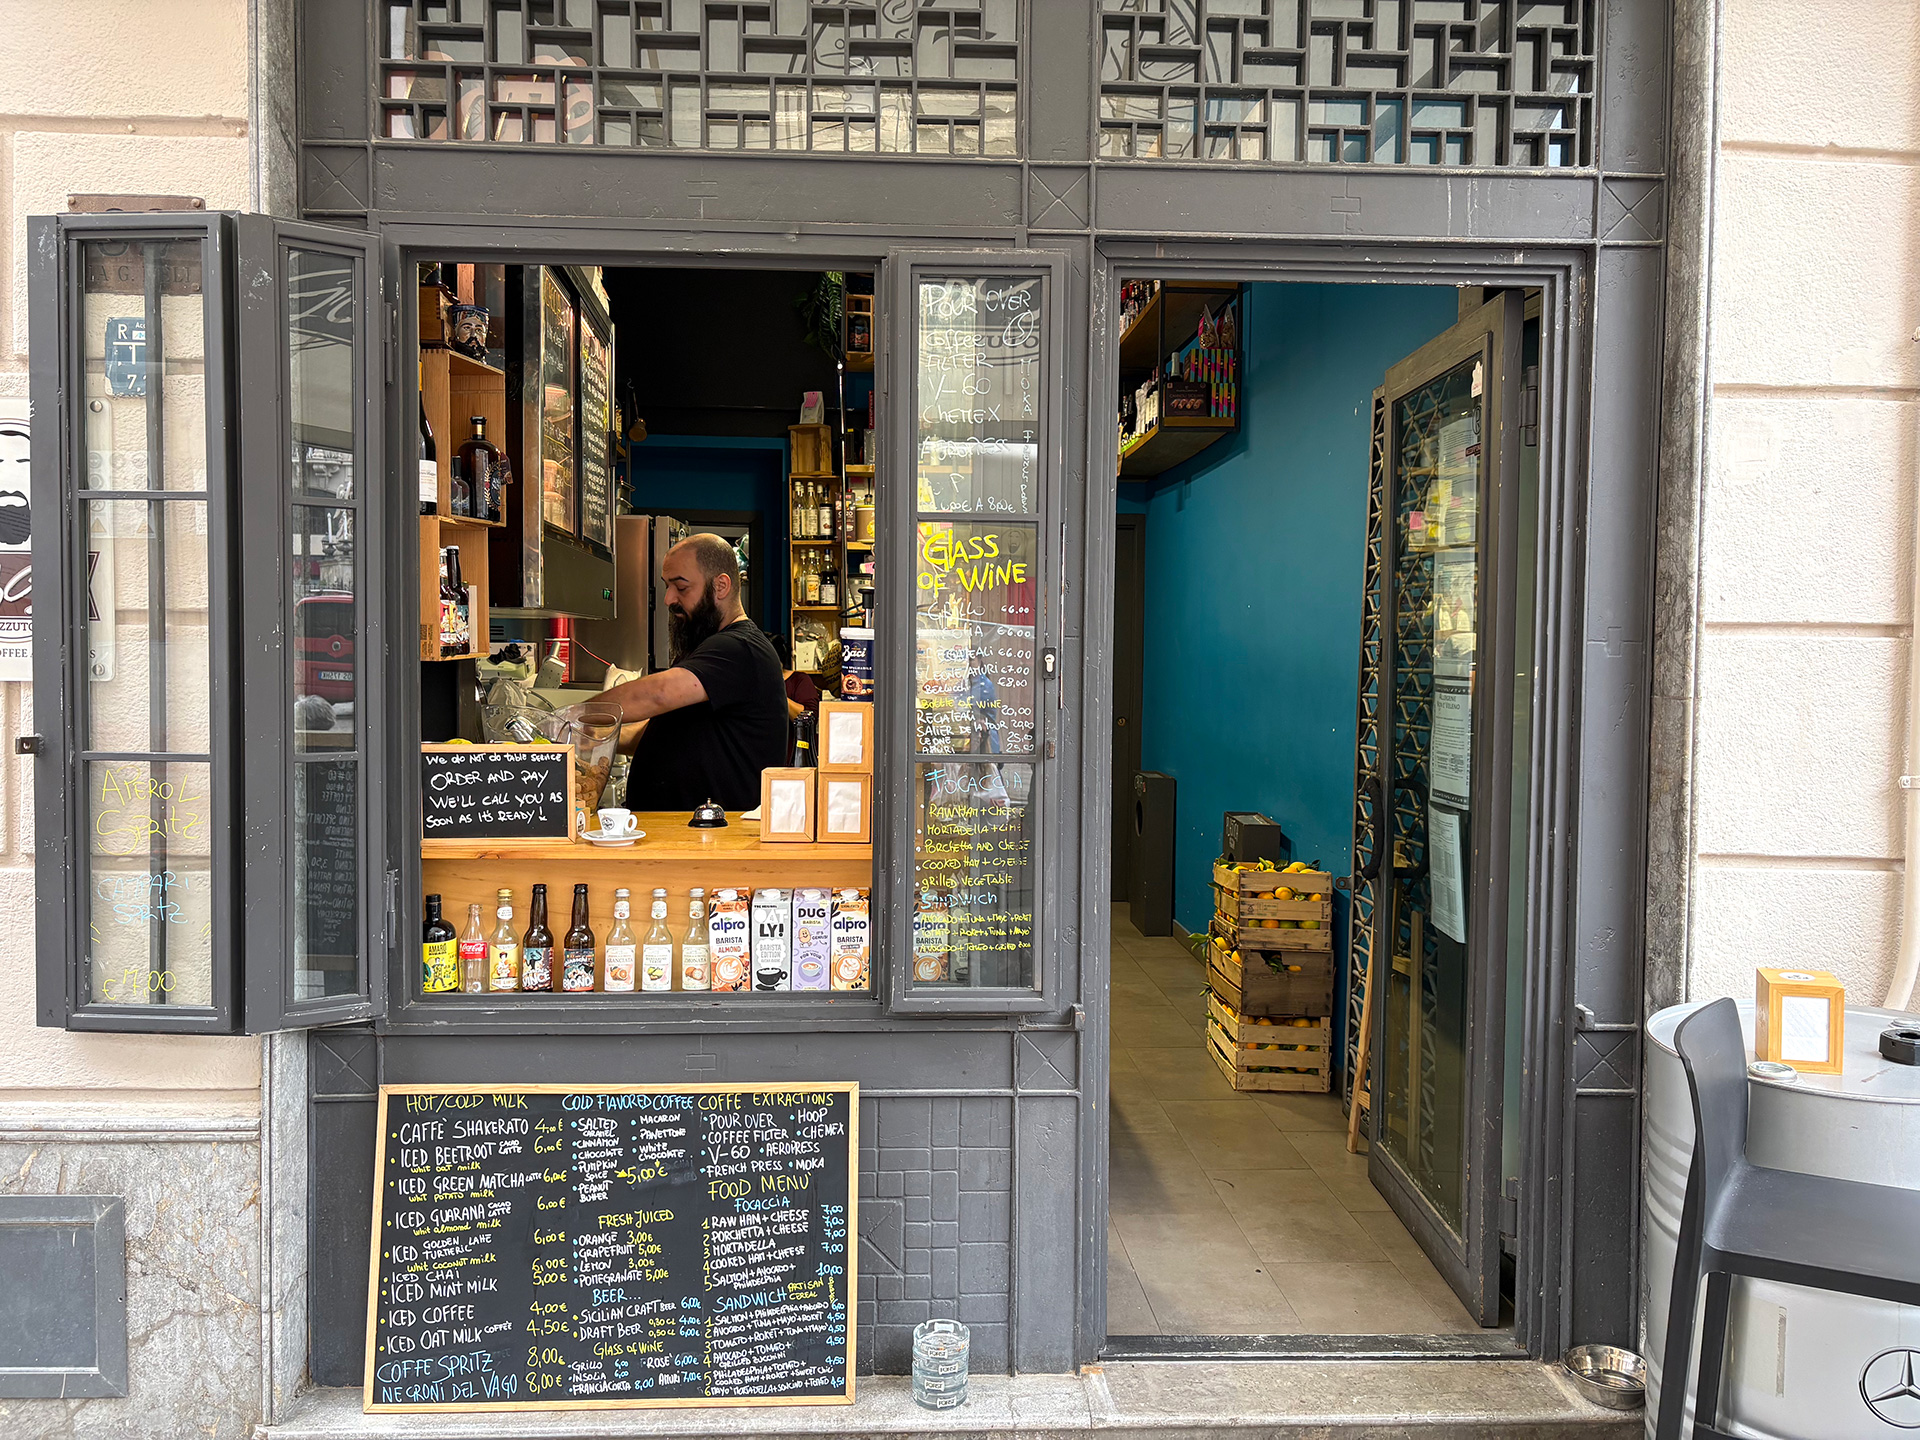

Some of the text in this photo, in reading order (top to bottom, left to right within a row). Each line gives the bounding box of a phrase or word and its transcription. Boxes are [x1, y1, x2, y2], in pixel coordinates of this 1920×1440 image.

[985, 285, 1031, 312] OVER
[117, 323, 128, 340] R
[956, 559, 1028, 593] WINE
[841, 644, 867, 662] Baci
[451, 755, 466, 765] do
[488, 752, 502, 762] do
[430, 769, 549, 791] ORDER AND PAY
[429, 791, 564, 809] WE'LL CALL YOU AS
[458, 813, 473, 824] AS
[975, 842, 994, 852] AND
[798, 908, 826, 918] DUG
[711, 917, 746, 933] alpro
[759, 923, 784, 938] LY!
[833, 918, 867, 933] alpro
[715, 937, 743, 945] BARISTA
[717, 945, 742, 953] ALMOND
[492, 1094, 529, 1110] MILK
[561, 1094, 594, 1111] COLD
[652, 1094, 695, 1111] COFFEE
[697, 1093, 742, 1111] COFFE
[577, 1117, 618, 1131] SALTED
[708, 1112, 778, 1131] POUR OVER
[797, 1107, 828, 1124] HOOP
[452, 1118, 529, 1140] SHAKERATO
[707, 1129, 751, 1145] COFFEE
[400, 1147, 429, 1168] ICED
[435, 1141, 497, 1166] BEETROOT
[766, 1140, 821, 1157] AEROPRESS
[706, 1161, 748, 1178] FRENCH
[750, 1160, 783, 1173] PRESS
[795, 1157, 825, 1171] MOKA
[398, 1171, 525, 1195] ICED GREEN MATCHA
[707, 1178, 752, 1201] FOOD
[733, 1194, 791, 1213] FOCACCIA
[395, 1211, 426, 1230] ICED
[430, 1203, 486, 1226] GUARANA
[598, 1212, 634, 1230] FRESH
[711, 1215, 737, 1229] RAW
[578, 1231, 619, 1247] ORANGE
[711, 1225, 765, 1243] PORCHETTA
[392, 1245, 418, 1264] ICED
[710, 1255, 747, 1270] COOKED
[392, 1271, 420, 1283] ICED
[390, 1282, 424, 1305] ICED
[712, 1286, 788, 1313] SANDWICH
[389, 1309, 417, 1328] ICED
[422, 1304, 475, 1324] COFFEE
[626, 1300, 662, 1318] CRAFT
[386, 1335, 416, 1354] ICED
[420, 1328, 450, 1350] OAT
[452, 1323, 483, 1345] MILK
[578, 1322, 644, 1342] DRAFT BEER
[451, 1380, 480, 1402] DEL
